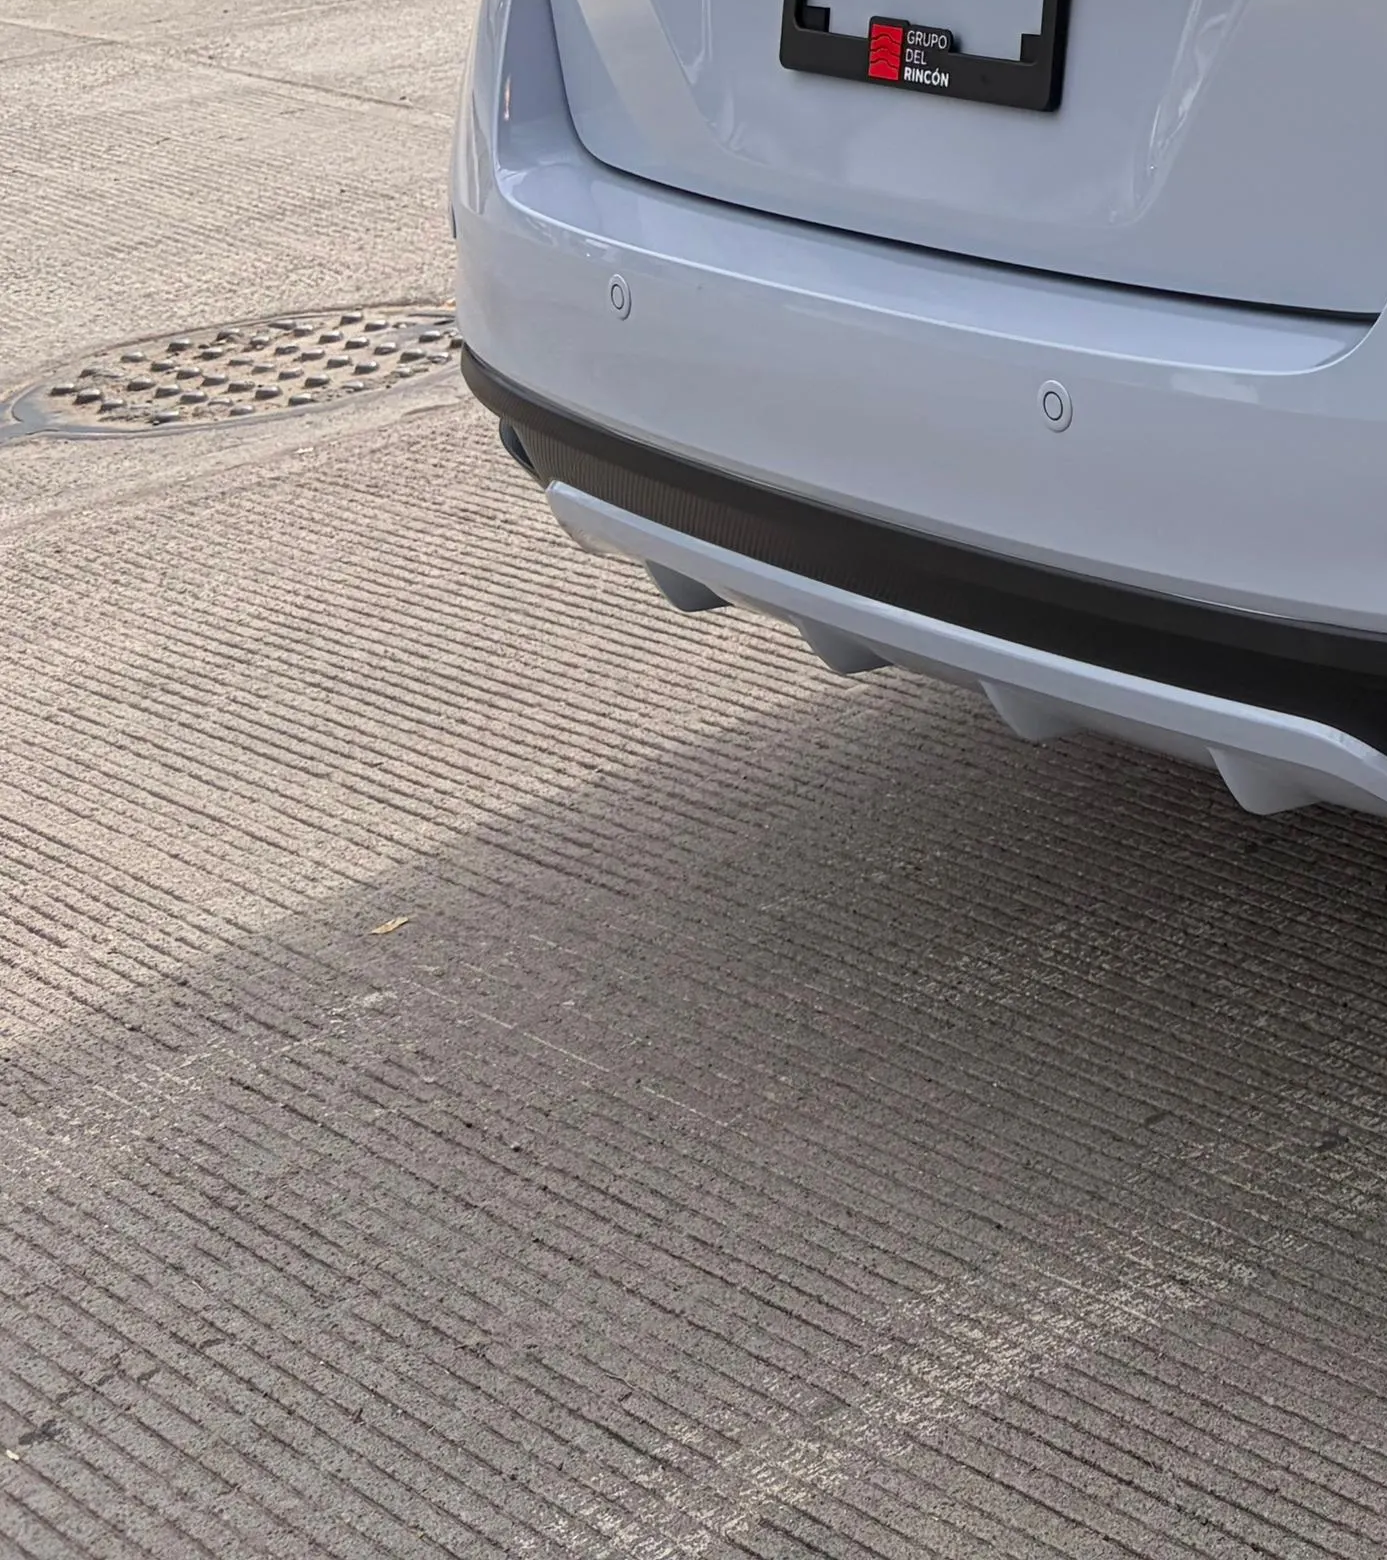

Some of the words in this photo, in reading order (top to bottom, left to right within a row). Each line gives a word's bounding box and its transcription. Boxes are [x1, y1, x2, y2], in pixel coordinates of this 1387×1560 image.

[906, 30, 948, 49] GRUPO
[905, 48, 927, 65] DEL
[903, 66, 950, 88] RINCÓN
